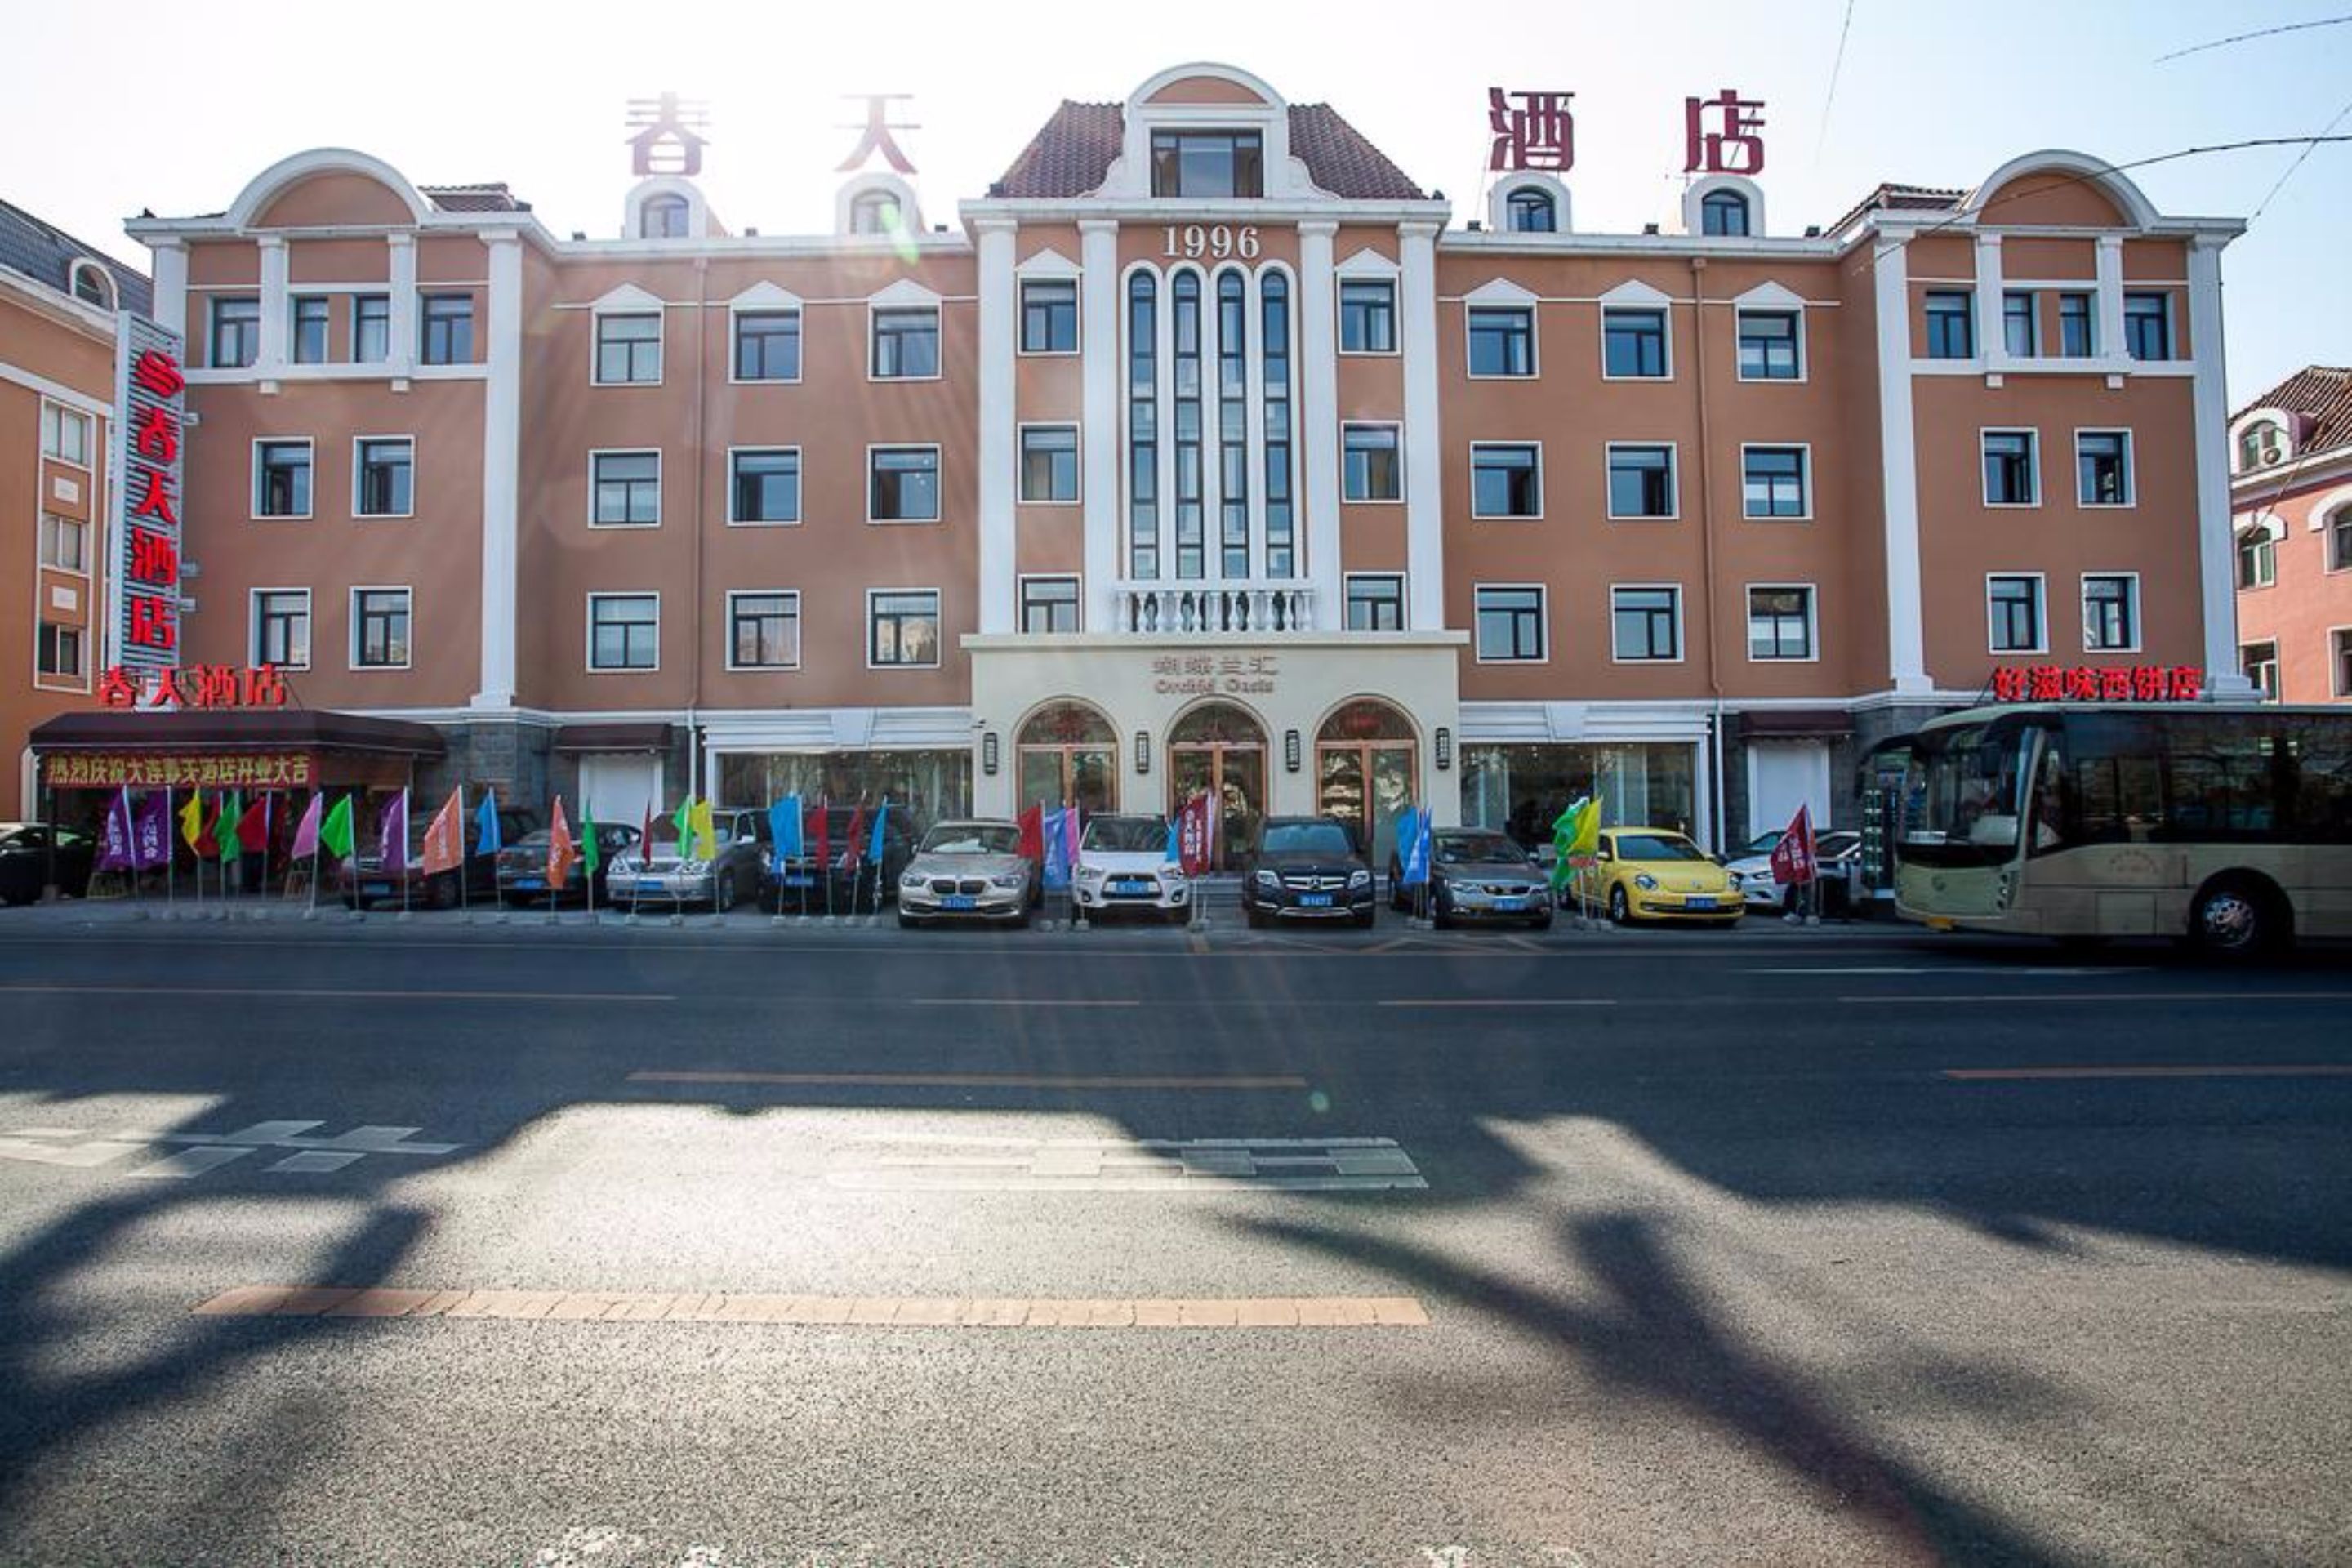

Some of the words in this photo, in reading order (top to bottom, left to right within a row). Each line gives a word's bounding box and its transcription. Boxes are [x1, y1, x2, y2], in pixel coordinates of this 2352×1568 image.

[1163, 225, 1260, 258] 1996
[131, 407, 178, 650] 春天酒店
[100, 663, 287, 708] 春天酒店
[1993, 666, 2203, 700] 好滋味西饼店
